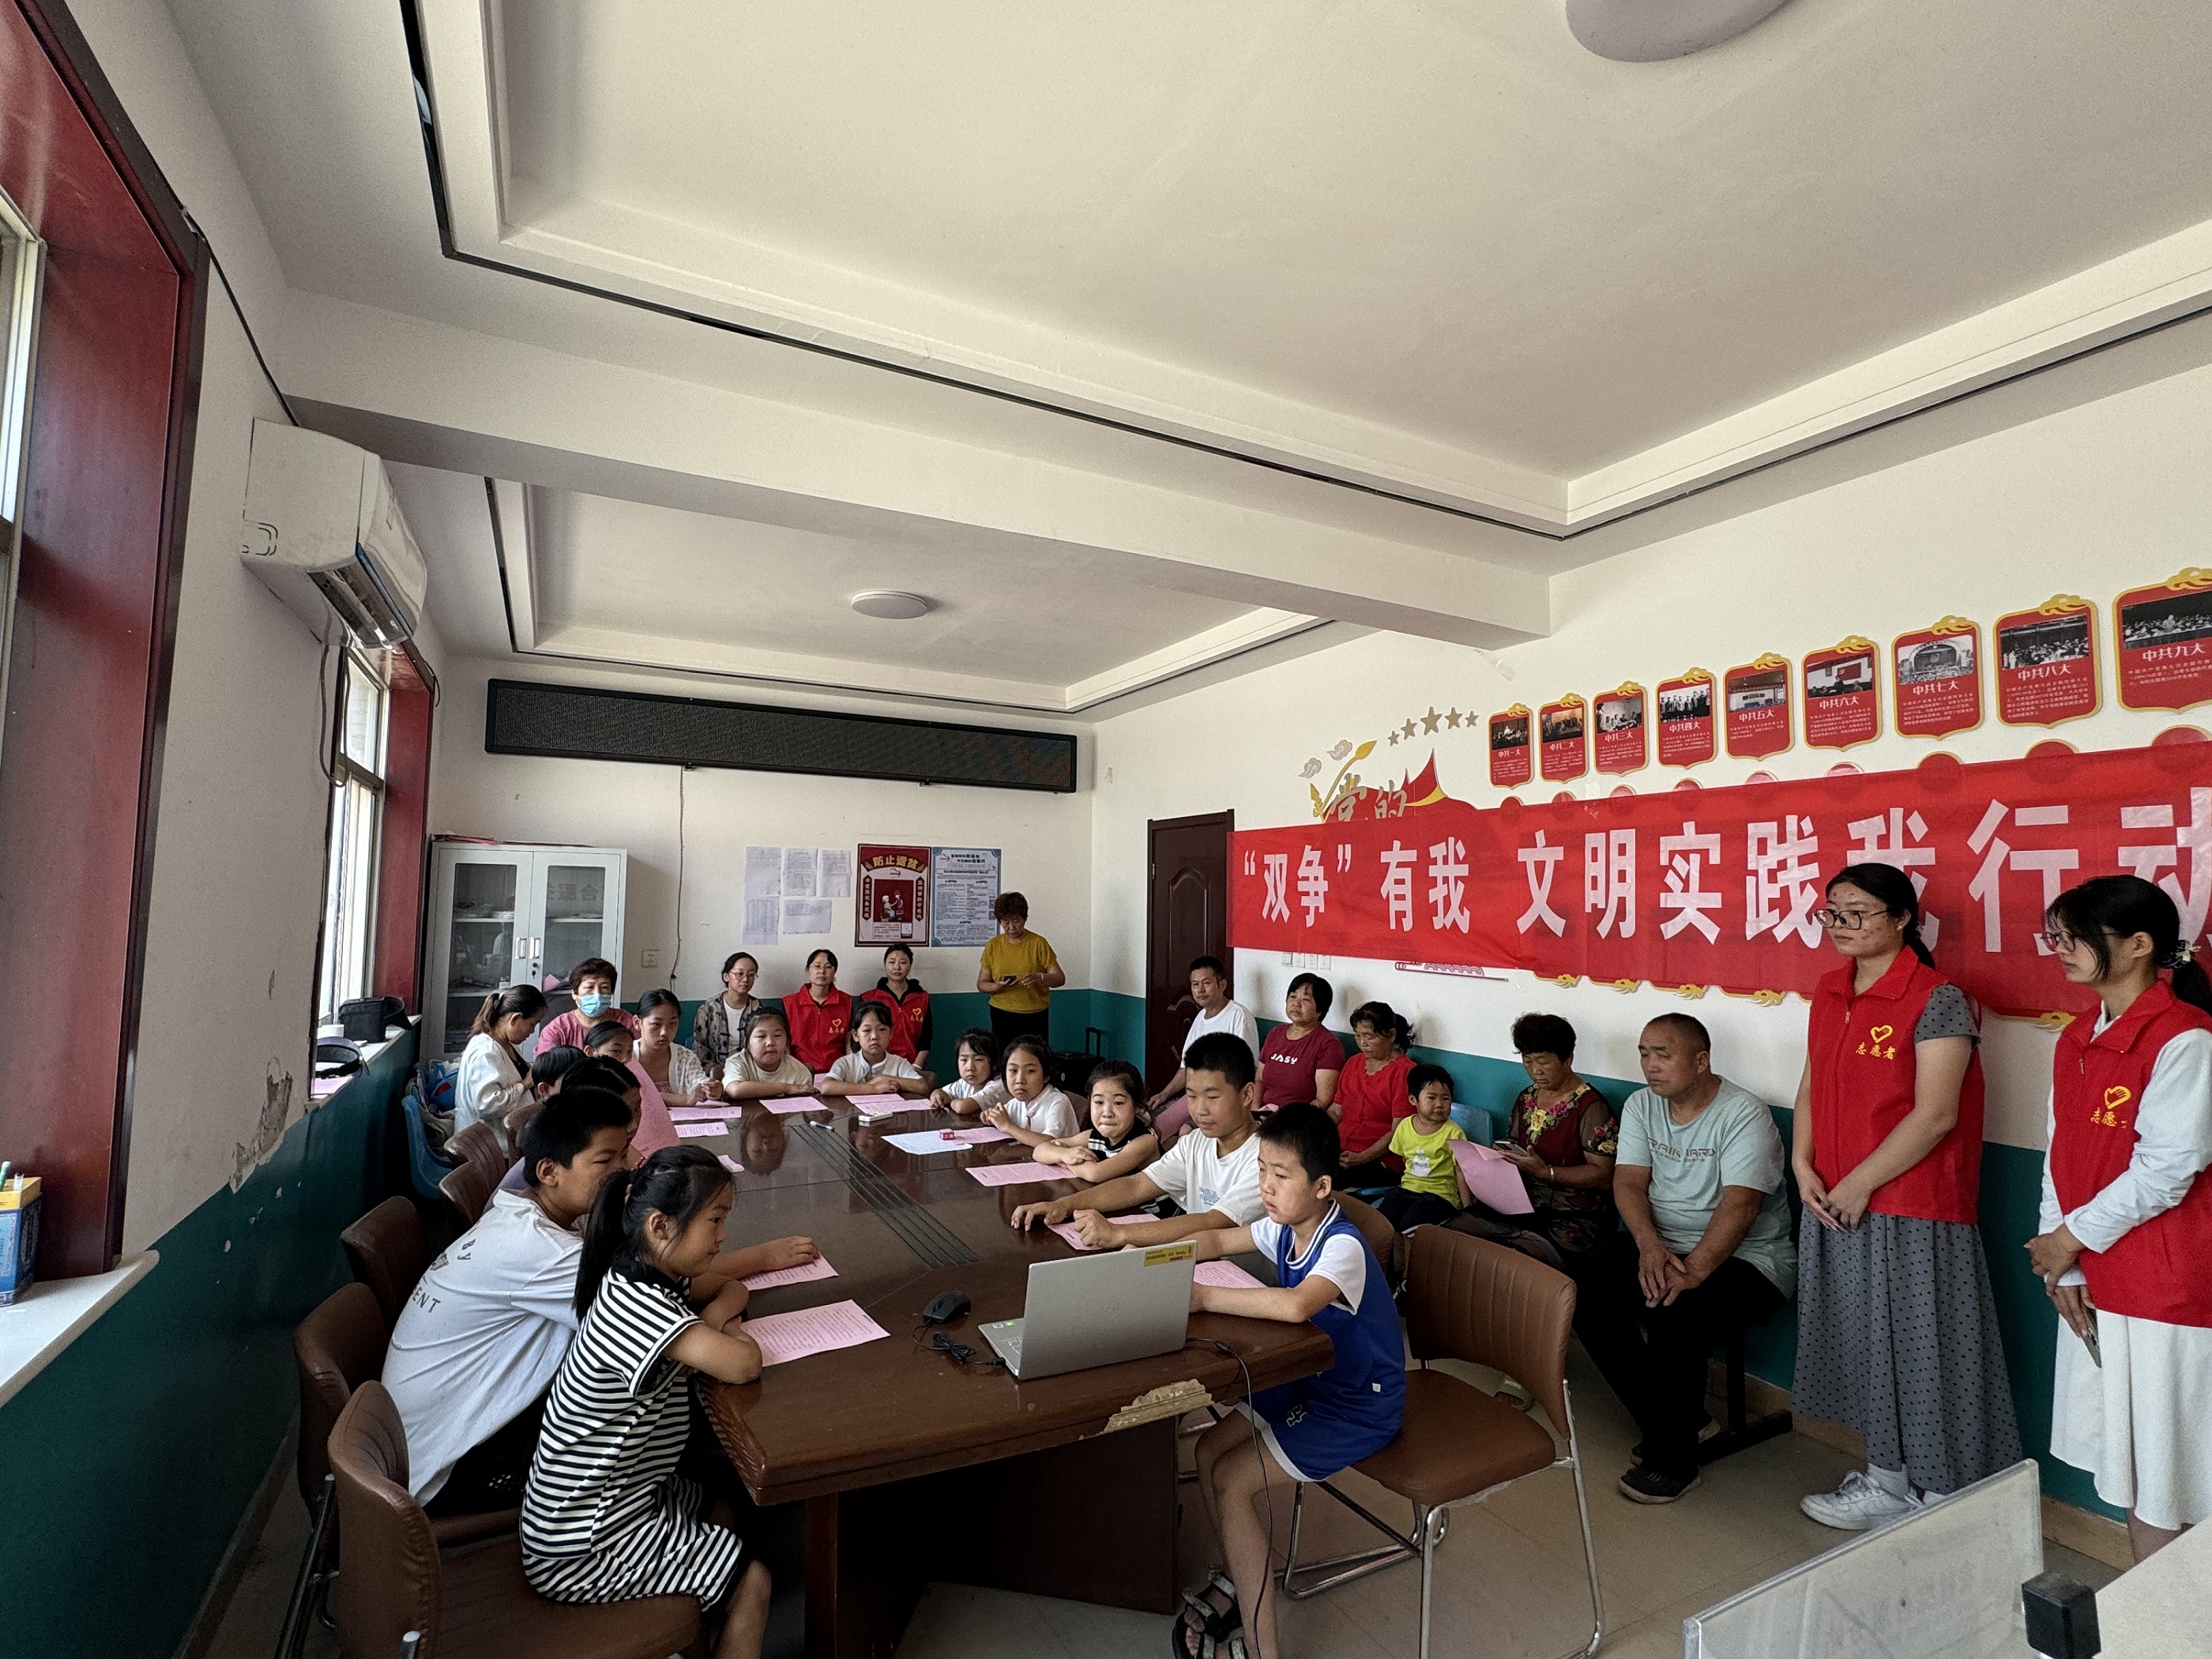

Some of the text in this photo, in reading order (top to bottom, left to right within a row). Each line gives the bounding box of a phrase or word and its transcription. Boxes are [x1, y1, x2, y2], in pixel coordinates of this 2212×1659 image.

[2142, 642, 2205, 661] 中共九大
[2018, 664, 2071, 681] 中共八大
[1913, 680, 1958, 695] 中共七大
[1819, 696, 1859, 709] 中共六大
[1739, 709, 1774, 722] 中共五大
[1669, 721, 1700, 732] 中共四大
[1604, 731, 1633, 742] 中共三大
[1550, 740, 1574, 750] 中共二大
[1856, 1041, 1896, 1060] 志愿者
